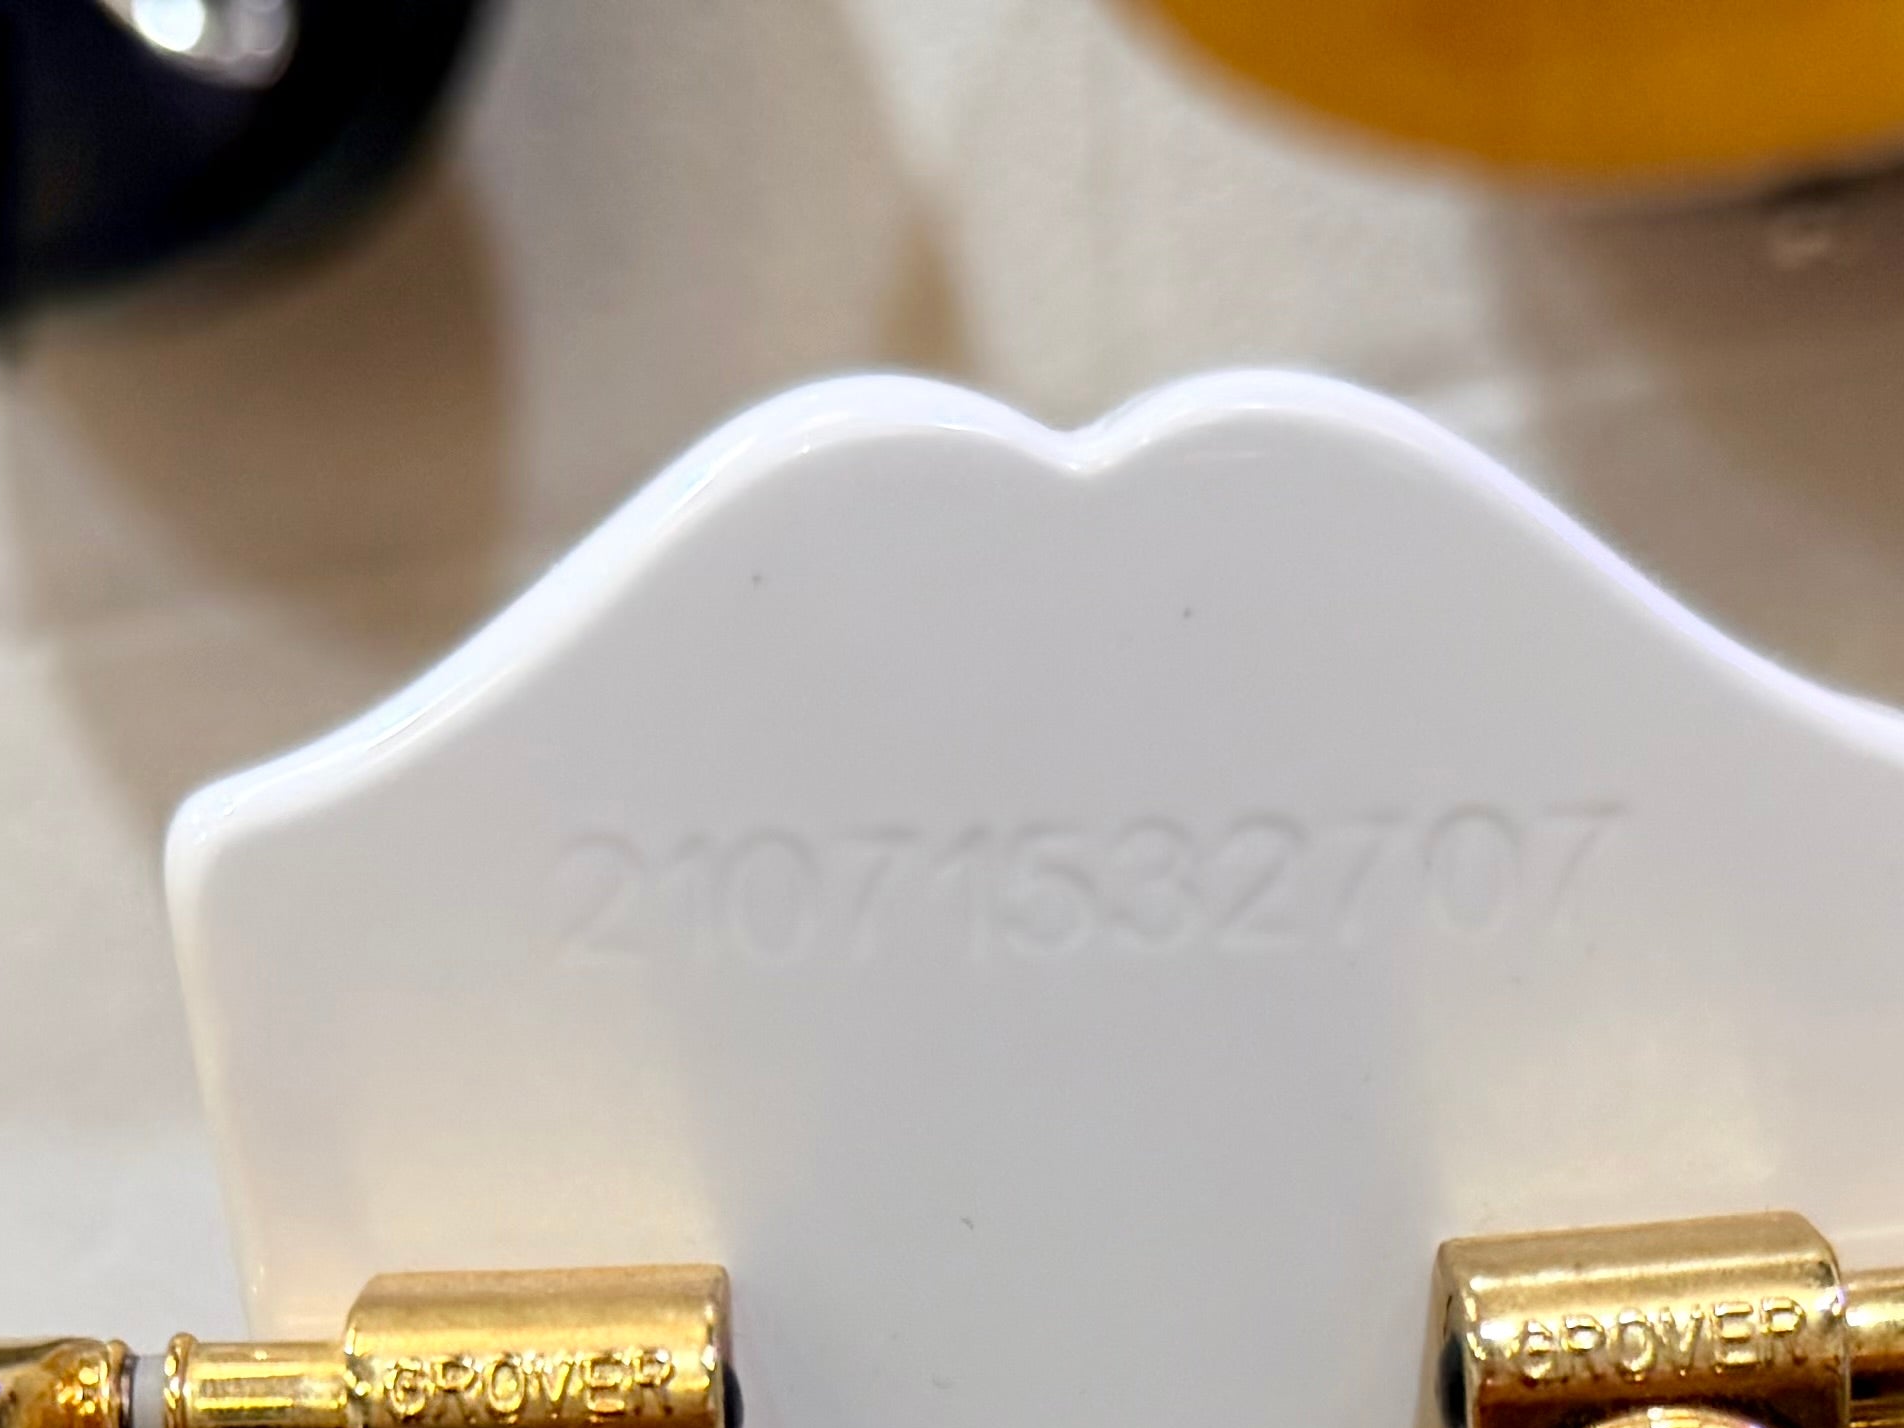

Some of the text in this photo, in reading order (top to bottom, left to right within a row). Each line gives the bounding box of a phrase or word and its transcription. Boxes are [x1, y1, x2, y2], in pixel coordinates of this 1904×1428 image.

[560, 802, 1628, 970] 21071532707
[382, 1346, 674, 1423] GROVER
[1517, 1298, 1807, 1387] GROVER
